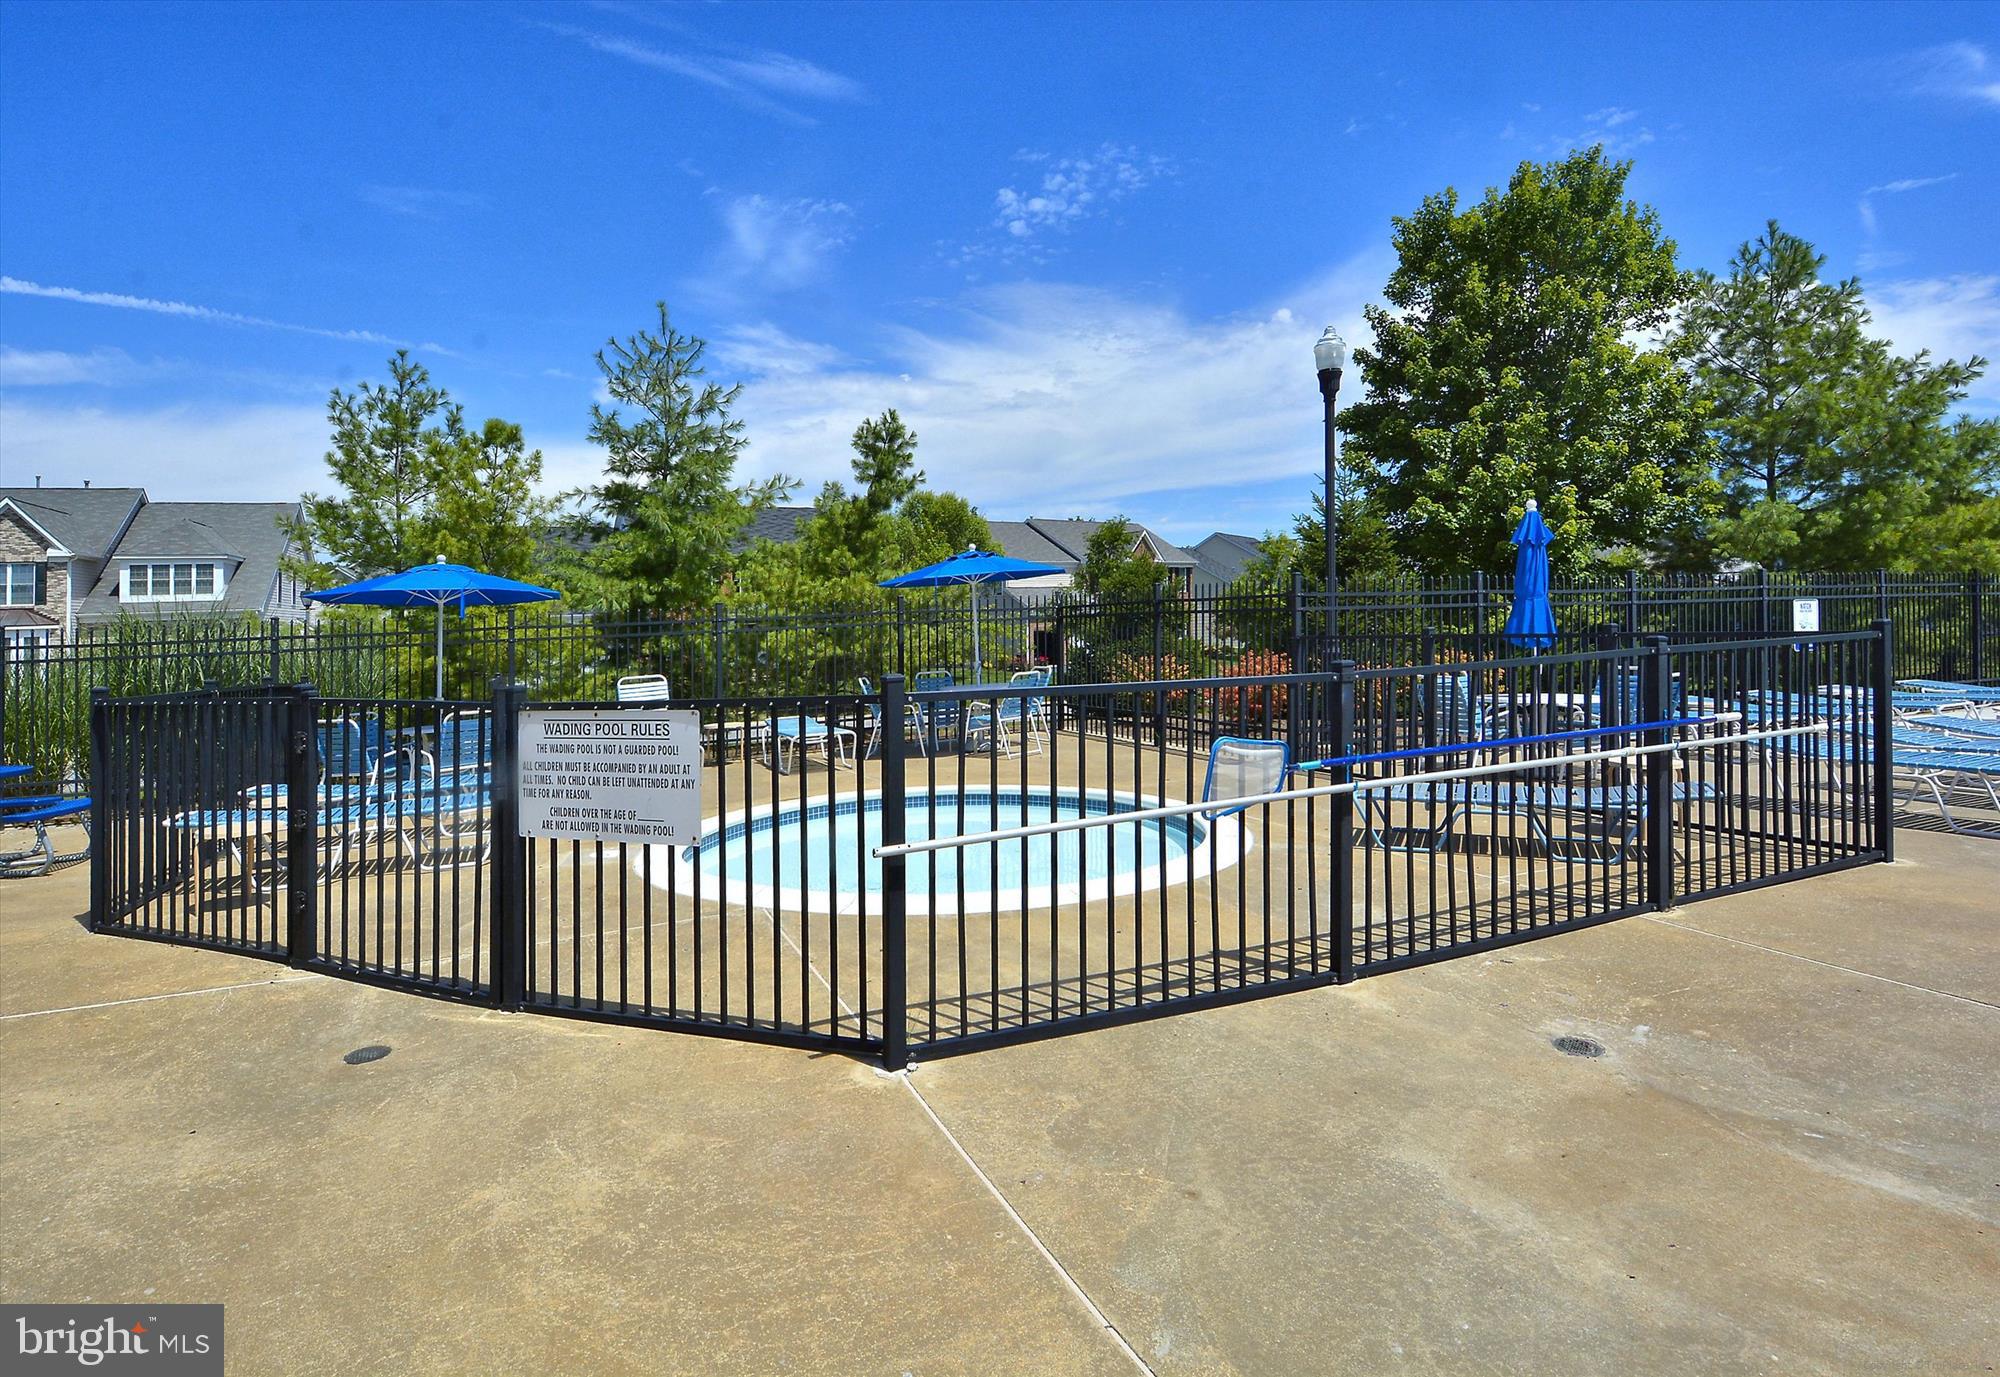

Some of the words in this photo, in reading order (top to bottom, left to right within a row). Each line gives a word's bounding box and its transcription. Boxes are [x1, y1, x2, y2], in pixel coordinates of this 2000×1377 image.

[544, 723, 590, 735] WADING
[596, 723, 626, 735] POOL
[631, 724, 670, 736] RULES
[537, 744, 547, 753] THE
[550, 744, 575, 754] WADING
[577, 745, 593, 754] POOL
[596, 745, 601, 754] IS
[603, 745, 615, 754] NOT
[618, 746, 622, 754] A
[625, 746, 655, 755] GUARDED
[658, 746, 679, 755] POOL!
[523, 761, 533, 771] ALL
[535, 762, 563, 771] CHILDREN
[565, 762, 581, 772] MUST
[583, 763, 590, 772] BE
[593, 763, 636, 773] ACCOMPANIED
[639, 764, 646, 773] BY
[648, 764, 657, 773] AN
[659, 764, 680, 774] ADULT
[682, 765, 690, 774] AT
[523, 775, 533, 784] ALL
[534, 775, 553, 785] TIMES.
[557, 776, 566, 785] NO
[568, 776, 586, 786] CHILD
[588, 777, 600, 786] CAN
[603, 777, 610, 786] BE
[612, 777, 625, 787] LEFT
[627, 778, 668, 788] UNATTENDED
[671, 779, 679, 788] AT
[681, 779, 695, 789] ANY
[523, 788, 537, 798] TIME
[539, 788, 550, 798] FOR
[552, 789, 564, 799] ANY
[566, 789, 592, 800] REASON.
[550, 807, 579, 818] CHILDREN
[582, 808, 598, 819] OVER
[600, 809, 611, 819] THE
[614, 809, 626, 820] AGE
[628, 810, 636, 820] OF
[542, 820, 553, 830] ARE
[555, 820, 568, 830] NOT
[570, 821, 599, 832] ALLOWED
[602, 823, 608, 832] IN
[610, 823, 622, 833] THE
[624, 823, 650, 834] WADING
[653, 825, 674, 836] POOL!
